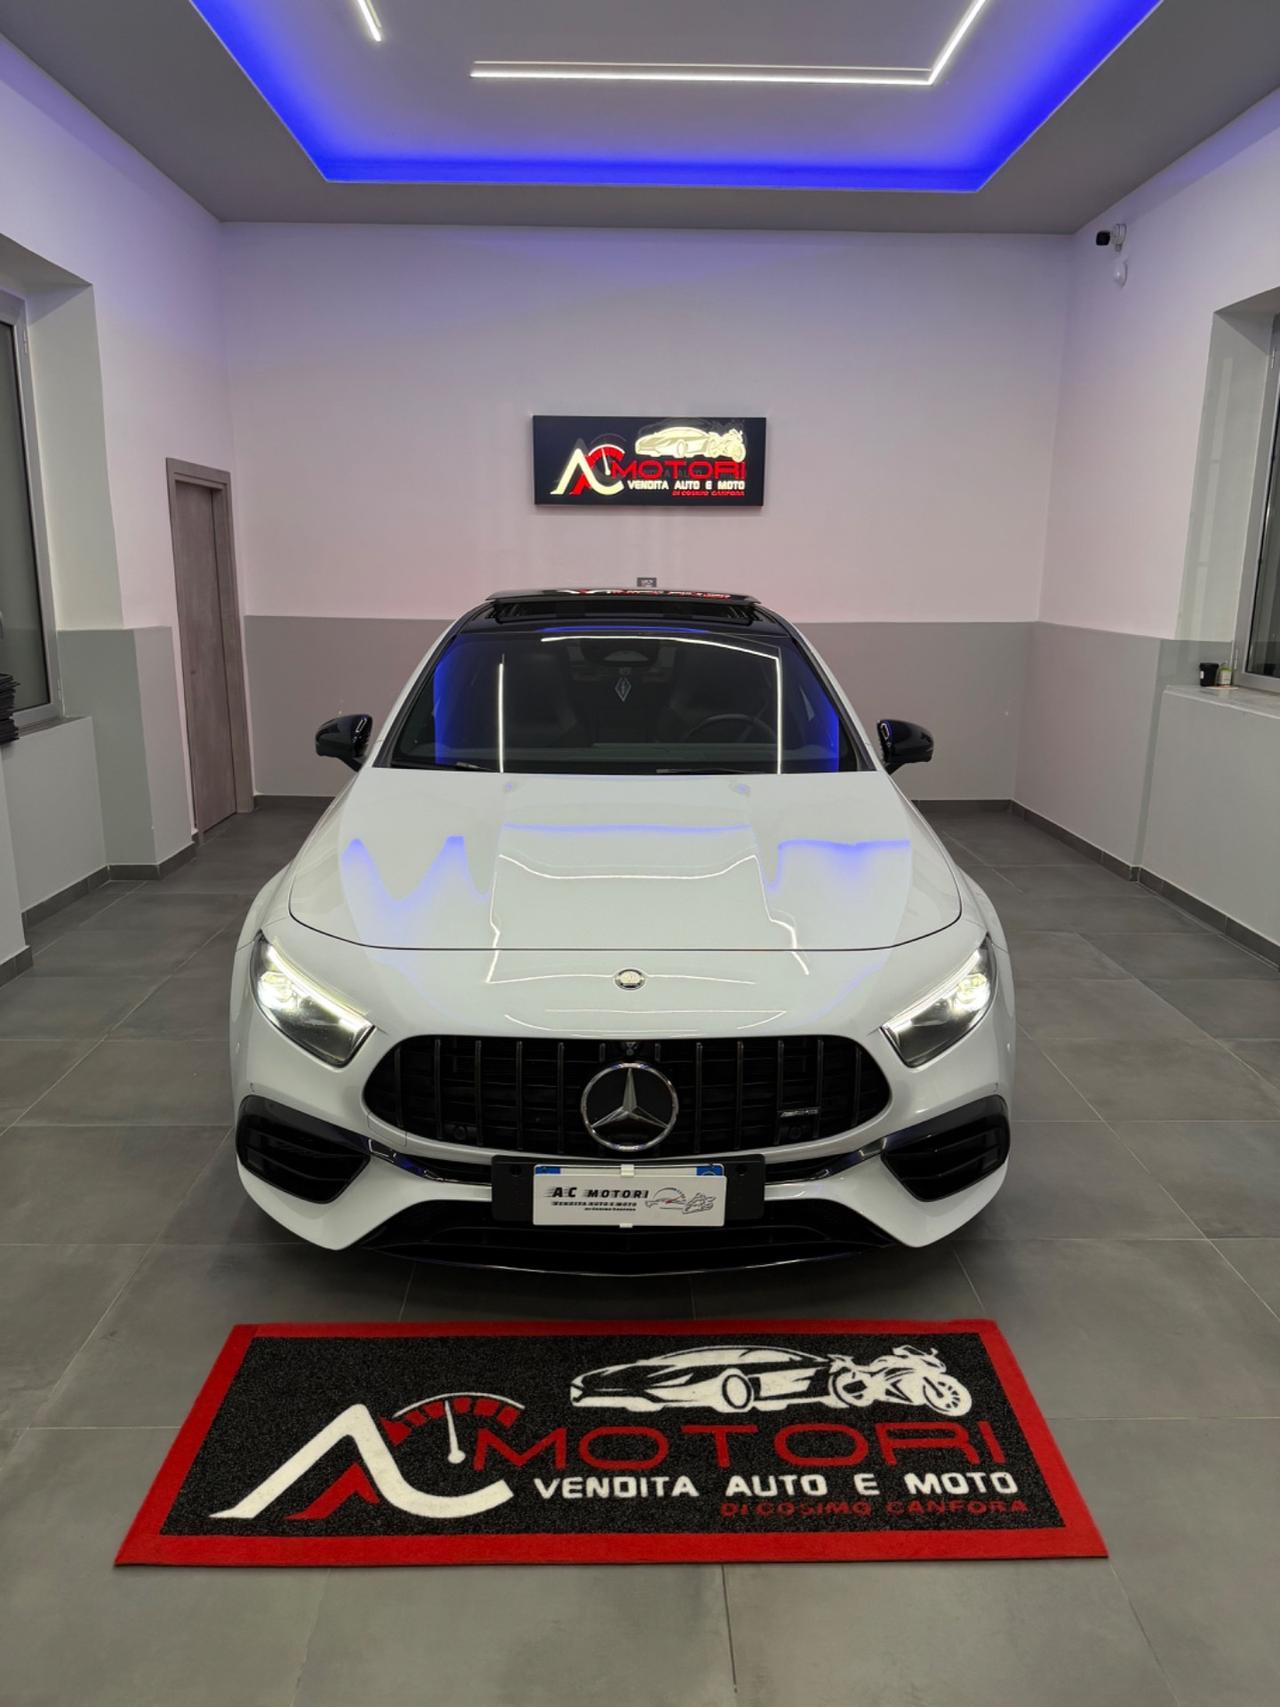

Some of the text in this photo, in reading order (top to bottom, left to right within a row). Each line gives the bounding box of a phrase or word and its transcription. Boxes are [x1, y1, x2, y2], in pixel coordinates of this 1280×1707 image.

[610, 460, 746, 479] MOTORI
[627, 480, 746, 490] VENDITA AUTO E MOTO
[587, 1190, 649, 1199] MOTORI
[473, 1420, 1006, 1471] MOTORI
[533, 1471, 1019, 1498] VENDITA AUTO E MOTO
[720, 1499, 1029, 1518] DI COSIMO CANFORA
